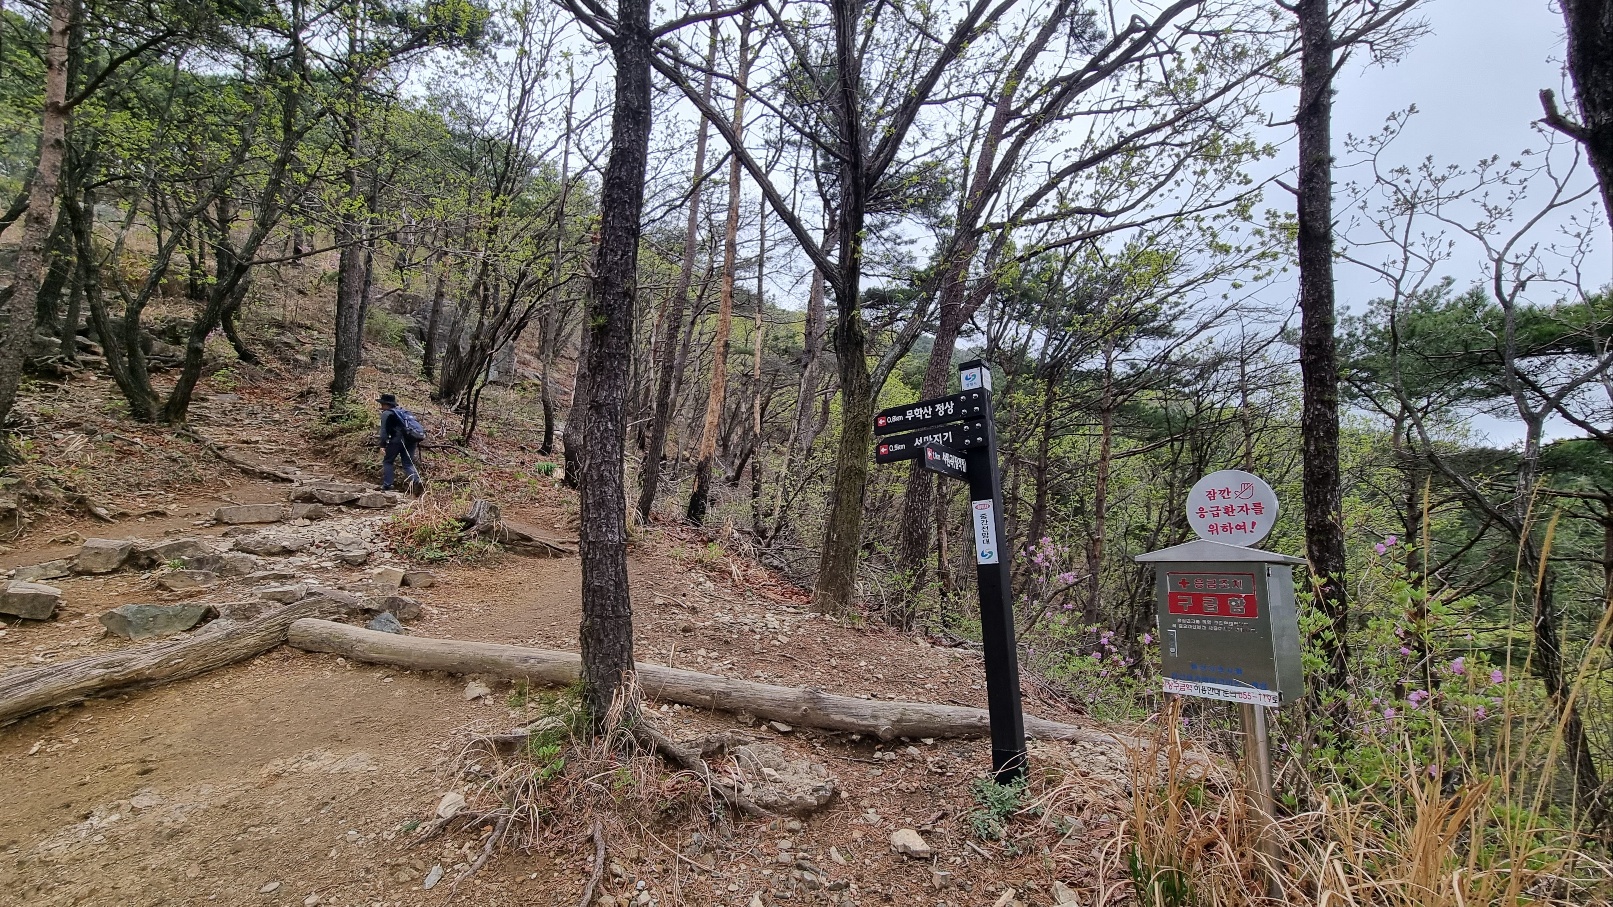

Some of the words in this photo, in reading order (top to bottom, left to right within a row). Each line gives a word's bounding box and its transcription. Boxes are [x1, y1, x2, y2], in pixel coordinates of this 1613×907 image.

[905, 406, 932, 420] 무학산
[935, 401, 954, 416] 정상
[1206, 487, 1231, 501] 잠깐
[1195, 502, 1265, 518] 응급환자를
[1208, 521, 1257, 535] 위하여!
[1194, 578, 1243, 590] 응급조치
[1178, 595, 1246, 614] 구급함
